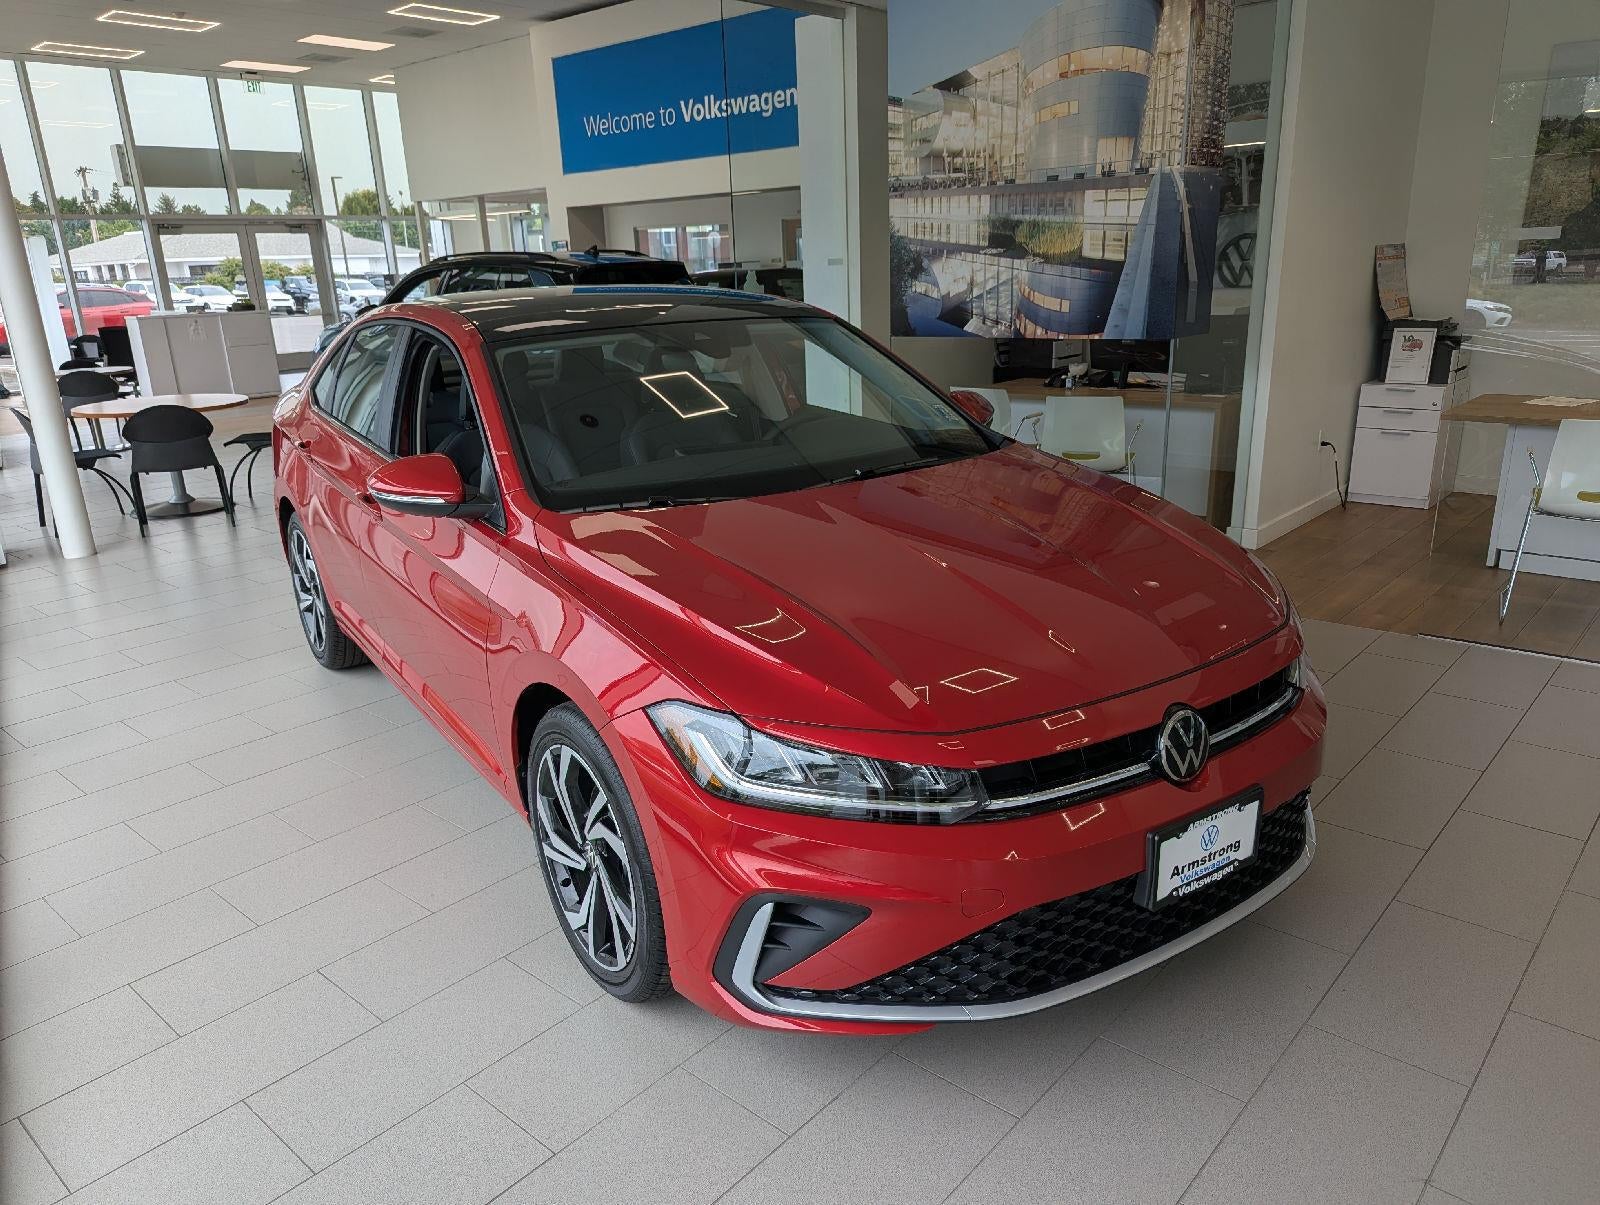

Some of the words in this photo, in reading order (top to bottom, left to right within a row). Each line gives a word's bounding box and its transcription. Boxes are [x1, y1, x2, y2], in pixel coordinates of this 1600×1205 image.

[246, 80, 261, 94] EXIT
[583, 112, 655, 138] Welcome
[660, 106, 676, 127] to
[680, 87, 799, 123] Volkswagen
[1170, 839, 1241, 880] Armstrong
[1180, 855, 1231, 883] Volkswagen
[1178, 864, 1235, 896] Volkswagen
